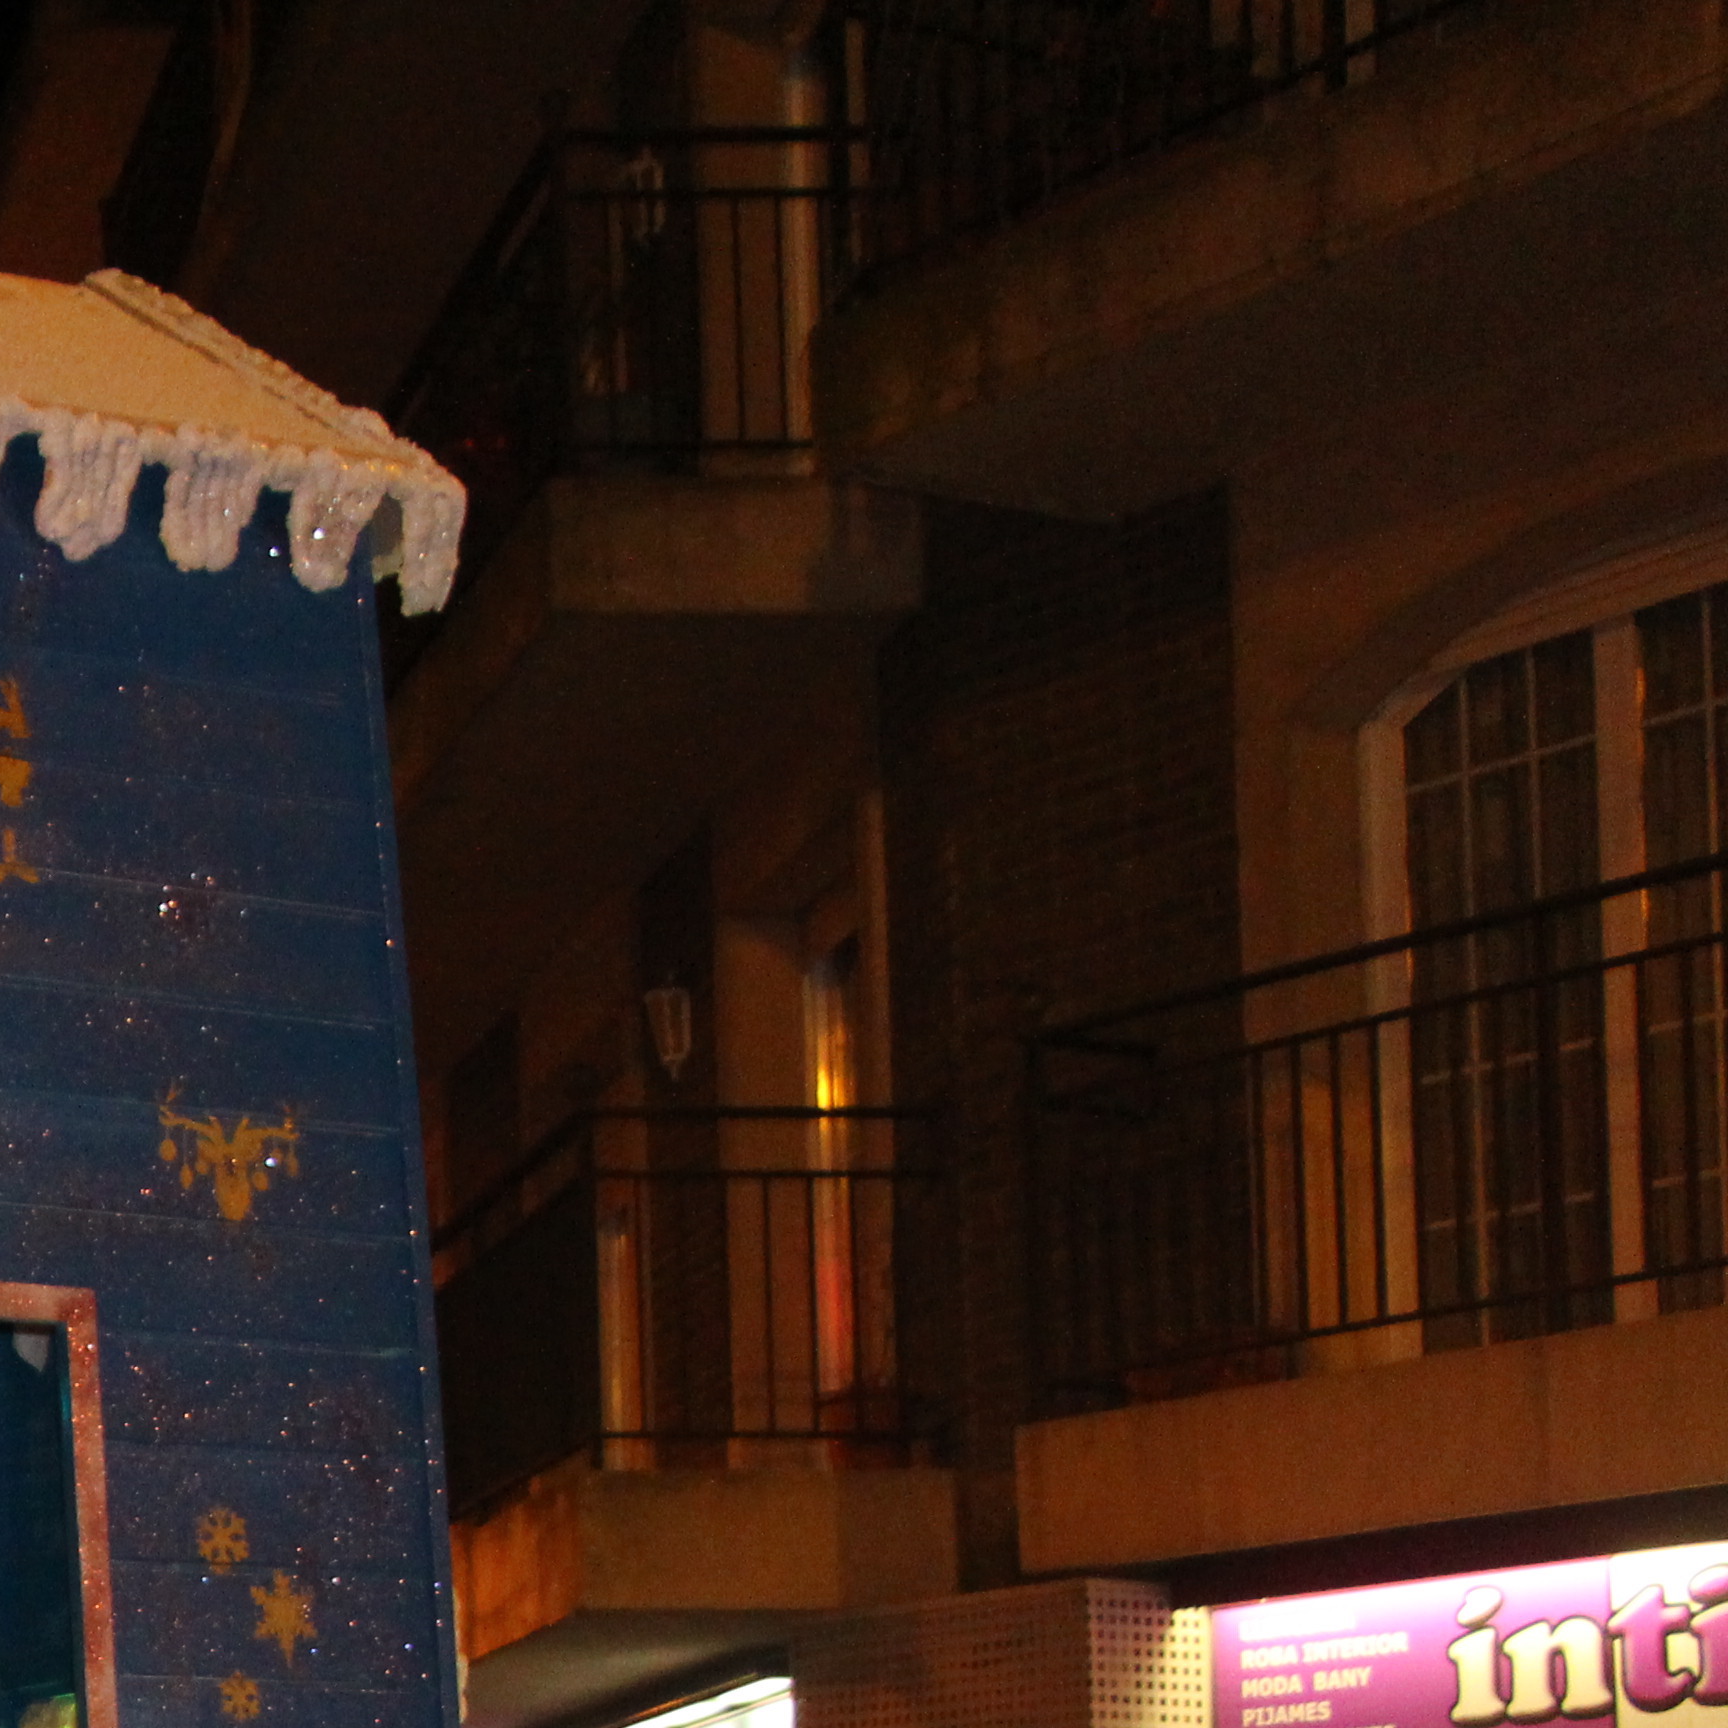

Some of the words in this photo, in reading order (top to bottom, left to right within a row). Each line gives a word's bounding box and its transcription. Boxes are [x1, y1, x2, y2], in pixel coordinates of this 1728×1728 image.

[1241, 1645, 1298, 1669] ROBA
[1302, 1632, 1409, 1663] INTERIOR
[1242, 1675, 1302, 1698] MODA
[1313, 1665, 1372, 1692] BANY
[1242, 1700, 1332, 1728] PIJAMES
